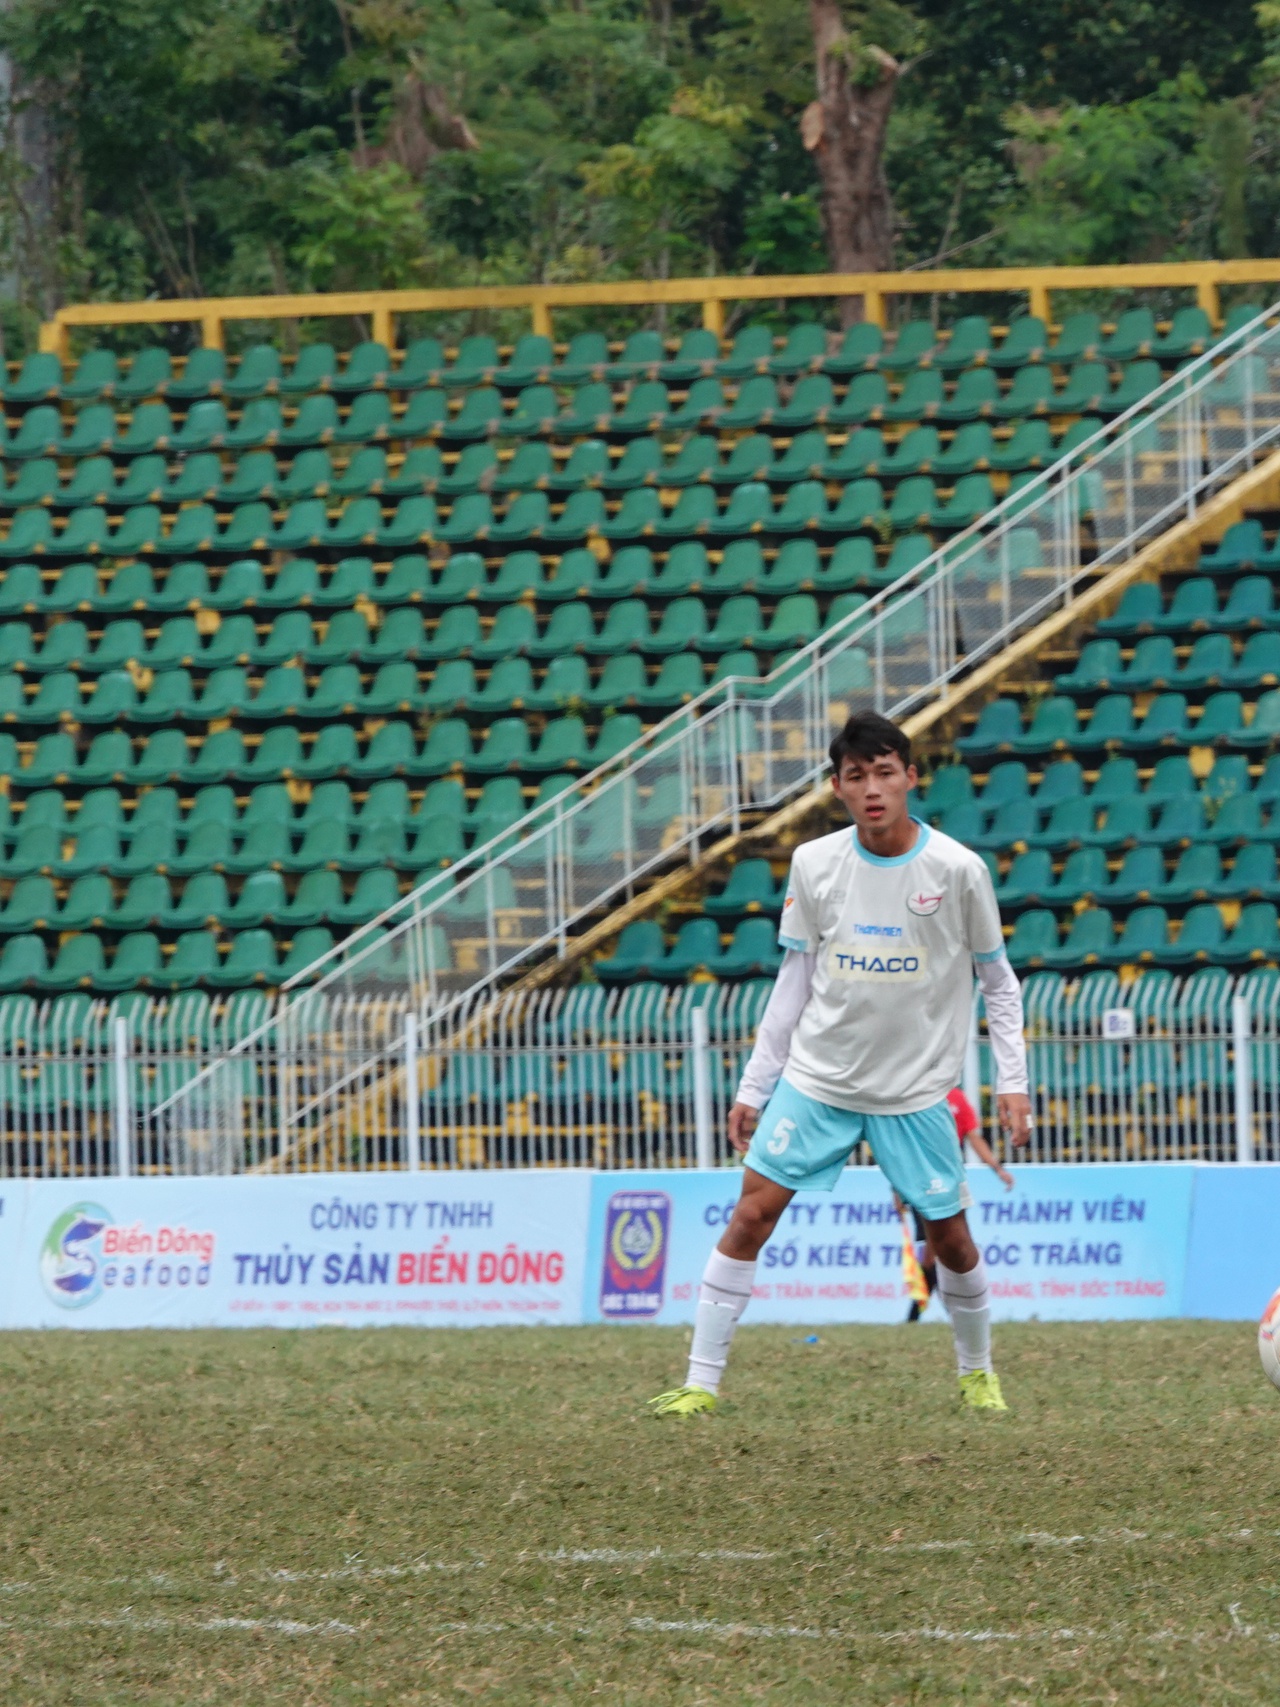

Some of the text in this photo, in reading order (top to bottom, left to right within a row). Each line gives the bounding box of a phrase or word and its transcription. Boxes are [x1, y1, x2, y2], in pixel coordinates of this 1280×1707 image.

[835, 953, 919, 973] THACO
[766, 1117, 797, 1156] 5
[310, 1196, 494, 1230] CÔNG TY TNHH
[788, 1203, 821, 1225] TY
[830, 1202, 904, 1225] TNHH
[1082, 1195, 1146, 1223] VIÊN
[233, 1234, 565, 1285] THỦY SẢN BIỂN ĐÔNG
